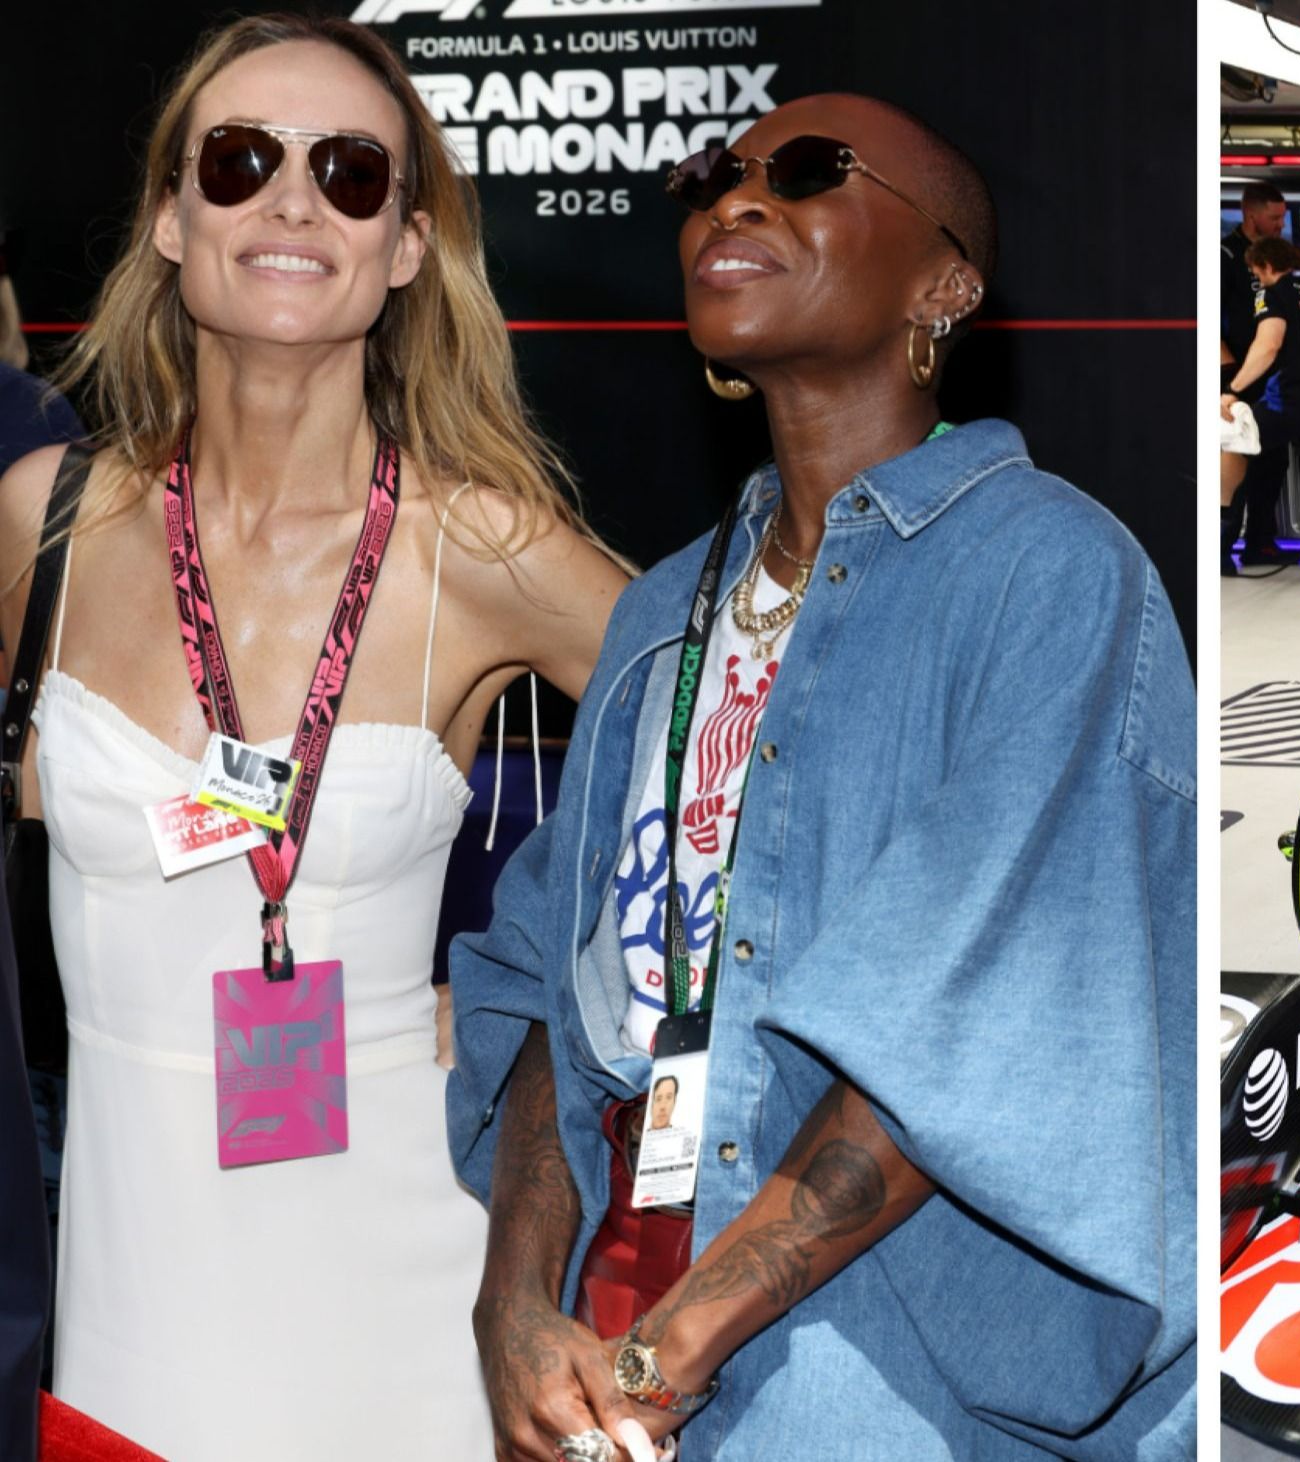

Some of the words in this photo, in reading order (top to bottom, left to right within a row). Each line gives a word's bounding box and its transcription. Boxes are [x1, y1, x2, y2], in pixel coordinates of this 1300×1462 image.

[408, 35, 526, 58] FORMULA
[533, 34, 547, 53] 1
[568, 30, 639, 53] LOUIS
[645, 27, 757, 51] VUITTON
[622, 64, 779, 117] PRIX
[536, 189, 630, 216] 2026
[374, 501, 394, 553] 2026
[667, 643, 702, 751] PADDOCK
[221, 740, 293, 790] VIP
[226, 1021, 322, 1067] VIP
